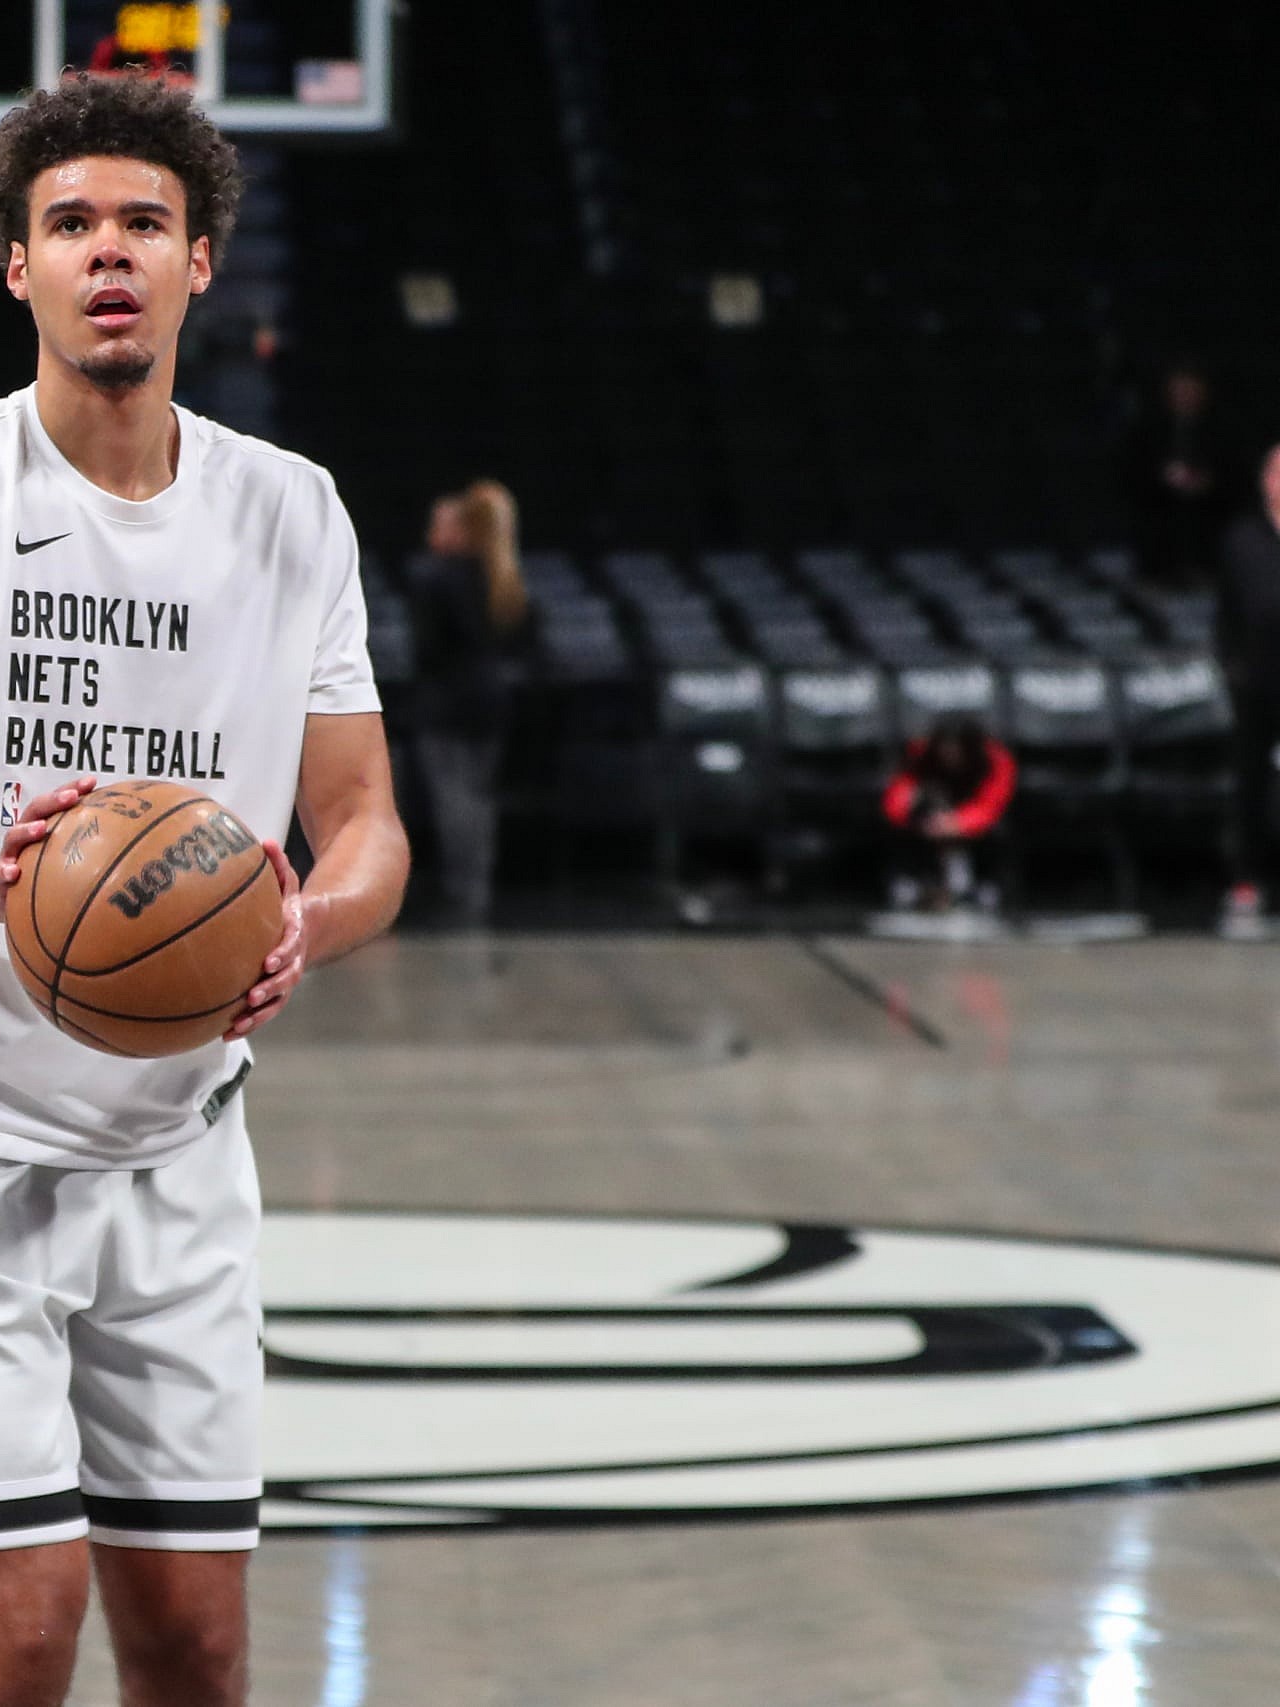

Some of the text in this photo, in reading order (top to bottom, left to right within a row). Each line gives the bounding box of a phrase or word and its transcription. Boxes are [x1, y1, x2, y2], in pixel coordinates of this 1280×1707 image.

[10, 588, 189, 652] BROOKLYN
[8, 652, 99, 707] NETS
[5, 716, 225, 780] BASKETBALL
